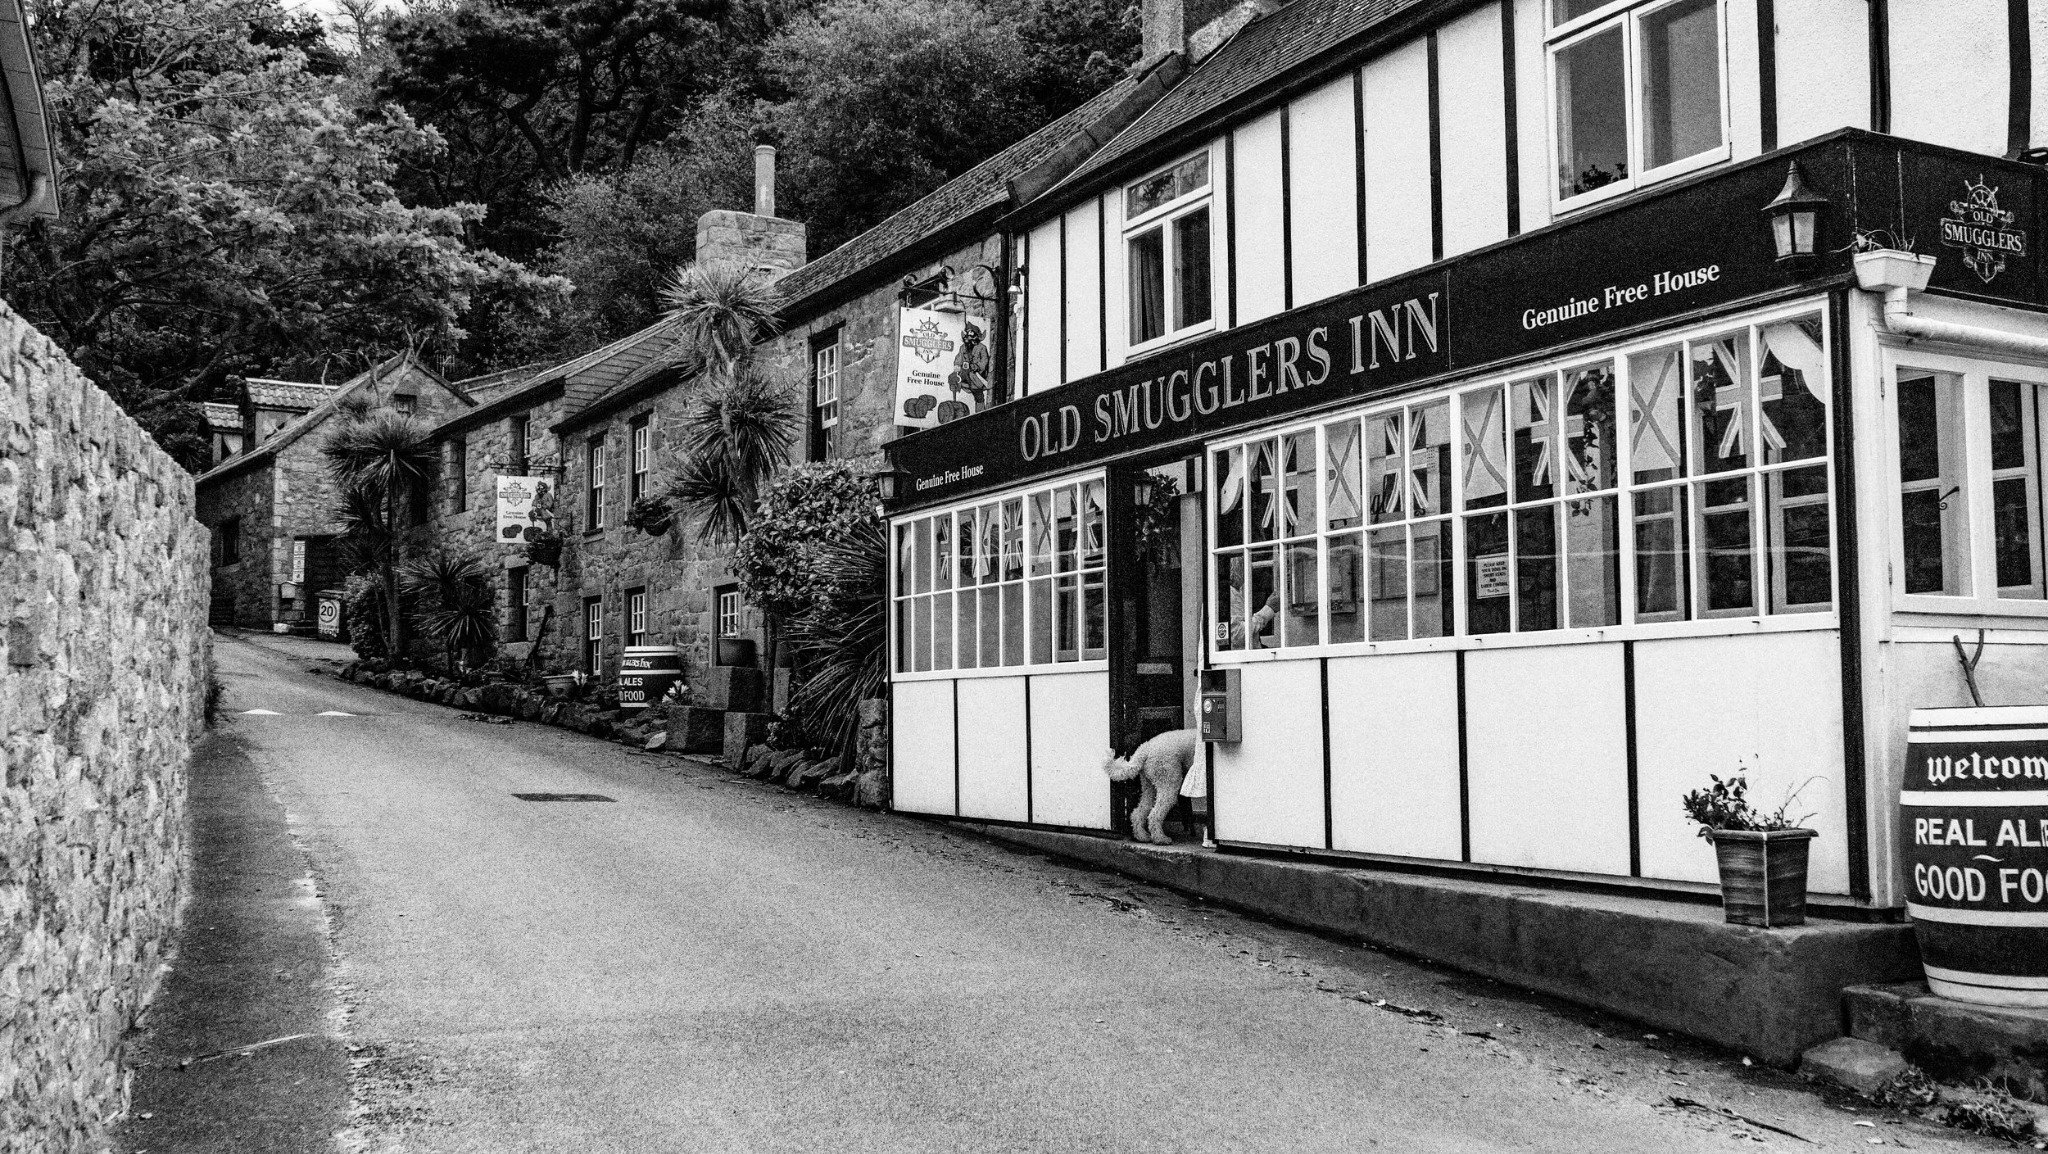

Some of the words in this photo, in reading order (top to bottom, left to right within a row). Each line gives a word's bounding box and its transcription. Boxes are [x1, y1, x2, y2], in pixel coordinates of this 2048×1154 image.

[1972, 211, 1994, 223] OLD
[1944, 223, 2022, 252] SMUGGLERS
[1522, 297, 1599, 329] Genuine
[1604, 284, 1648, 309] Free
[1653, 264, 1720, 296] House
[903, 336, 952, 351] SMUGGLERS
[907, 376, 922, 385] Free
[923, 378, 945, 387] House
[912, 370, 941, 379] Genuine
[1020, 404, 1081, 461] OLD
[1094, 326, 1331, 443] SMUGGLERS
[1349, 292, 1439, 375] INN
[915, 474, 943, 491] Genuine
[945, 470, 960, 484] Free
[961, 464, 984, 480] House
[320, 605, 334, 617] 20
[623, 677, 644, 686] ALES
[624, 690, 645, 701] FOOD
[1915, 818, 1987, 846] REAL
[1914, 863, 1986, 901] GOOD
[1999, 868, 2048, 903] FO
